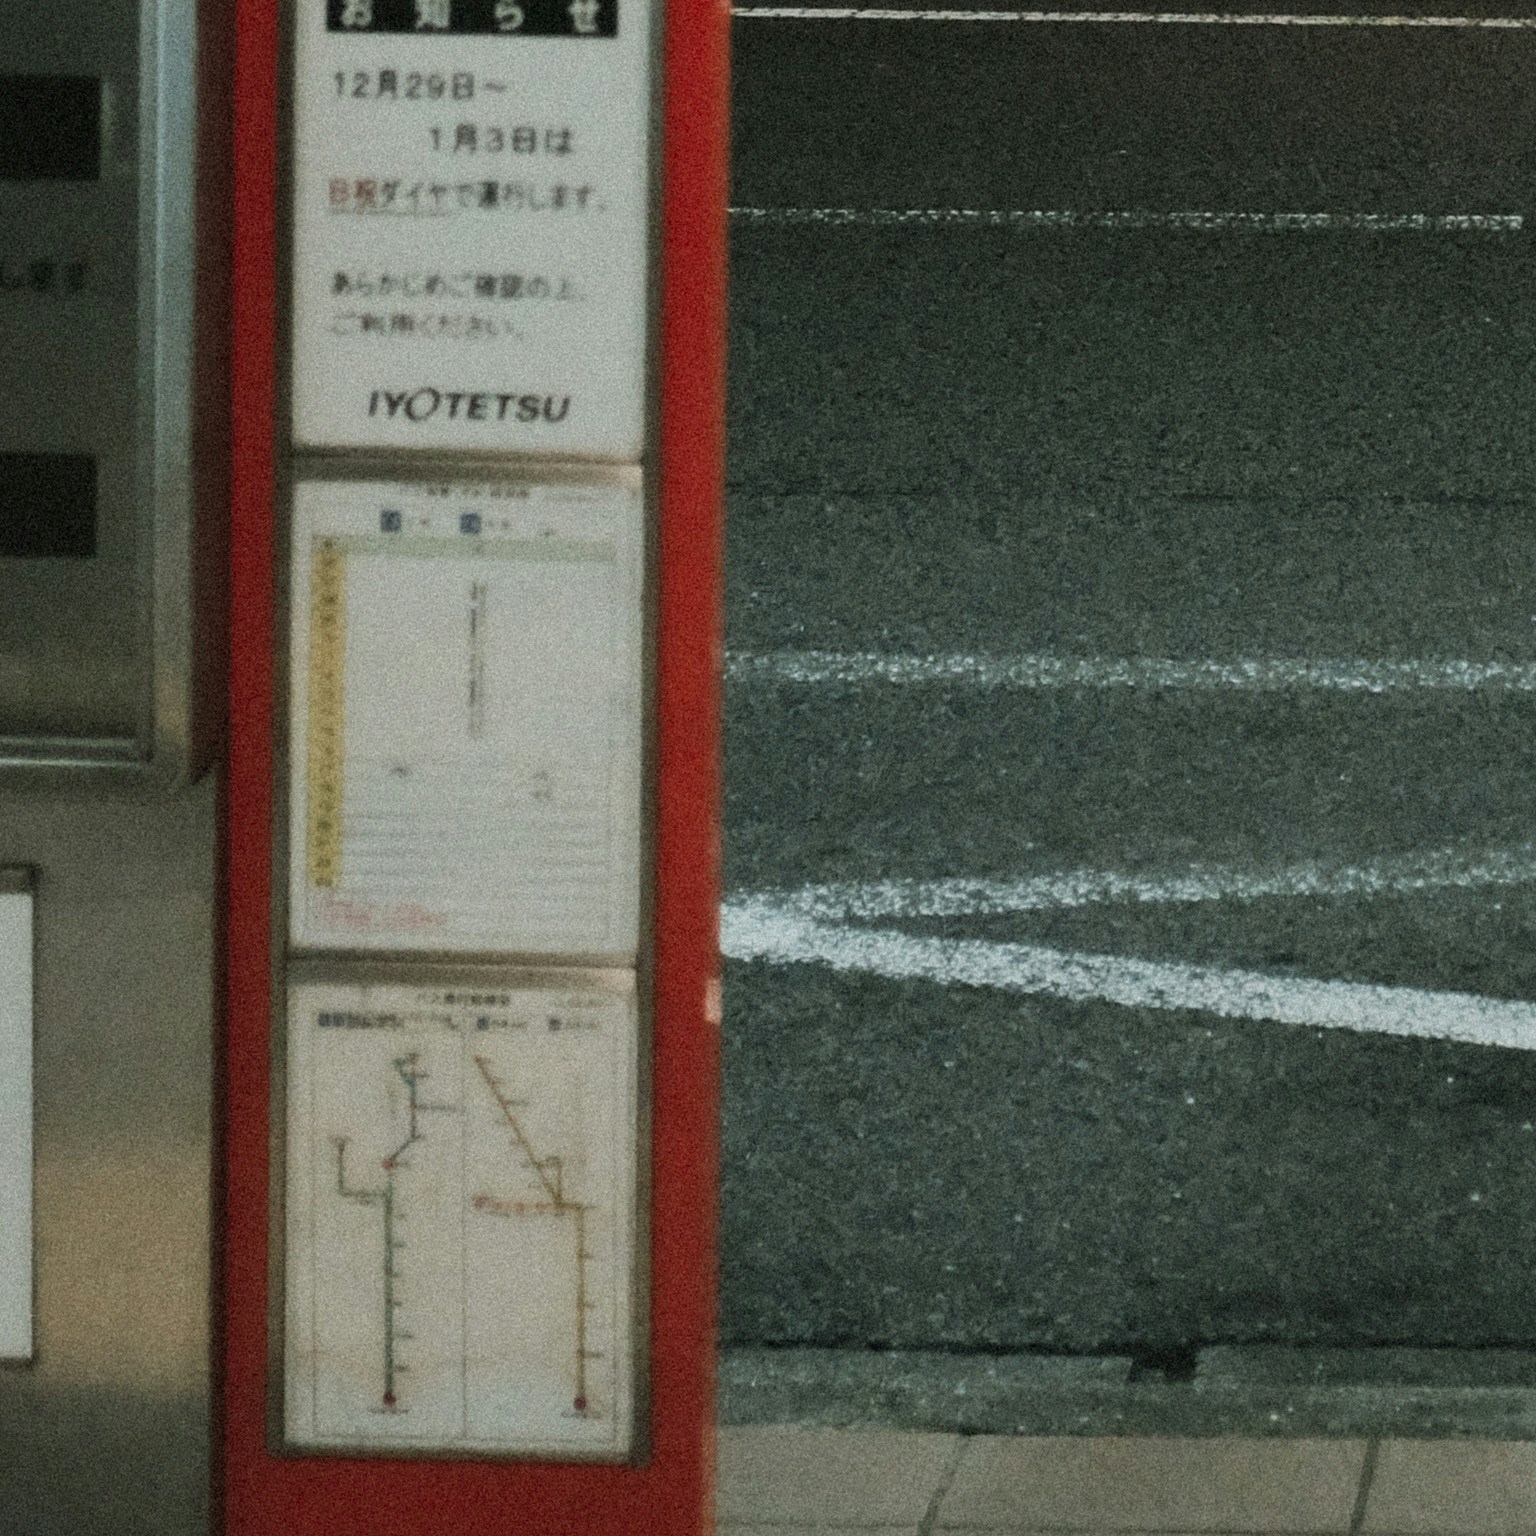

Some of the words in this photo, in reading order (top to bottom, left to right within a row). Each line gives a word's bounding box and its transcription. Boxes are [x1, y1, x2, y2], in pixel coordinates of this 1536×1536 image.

[428, 124, 573, 156] 1月3日は
[367, 387, 570, 423] IYOTETSU
